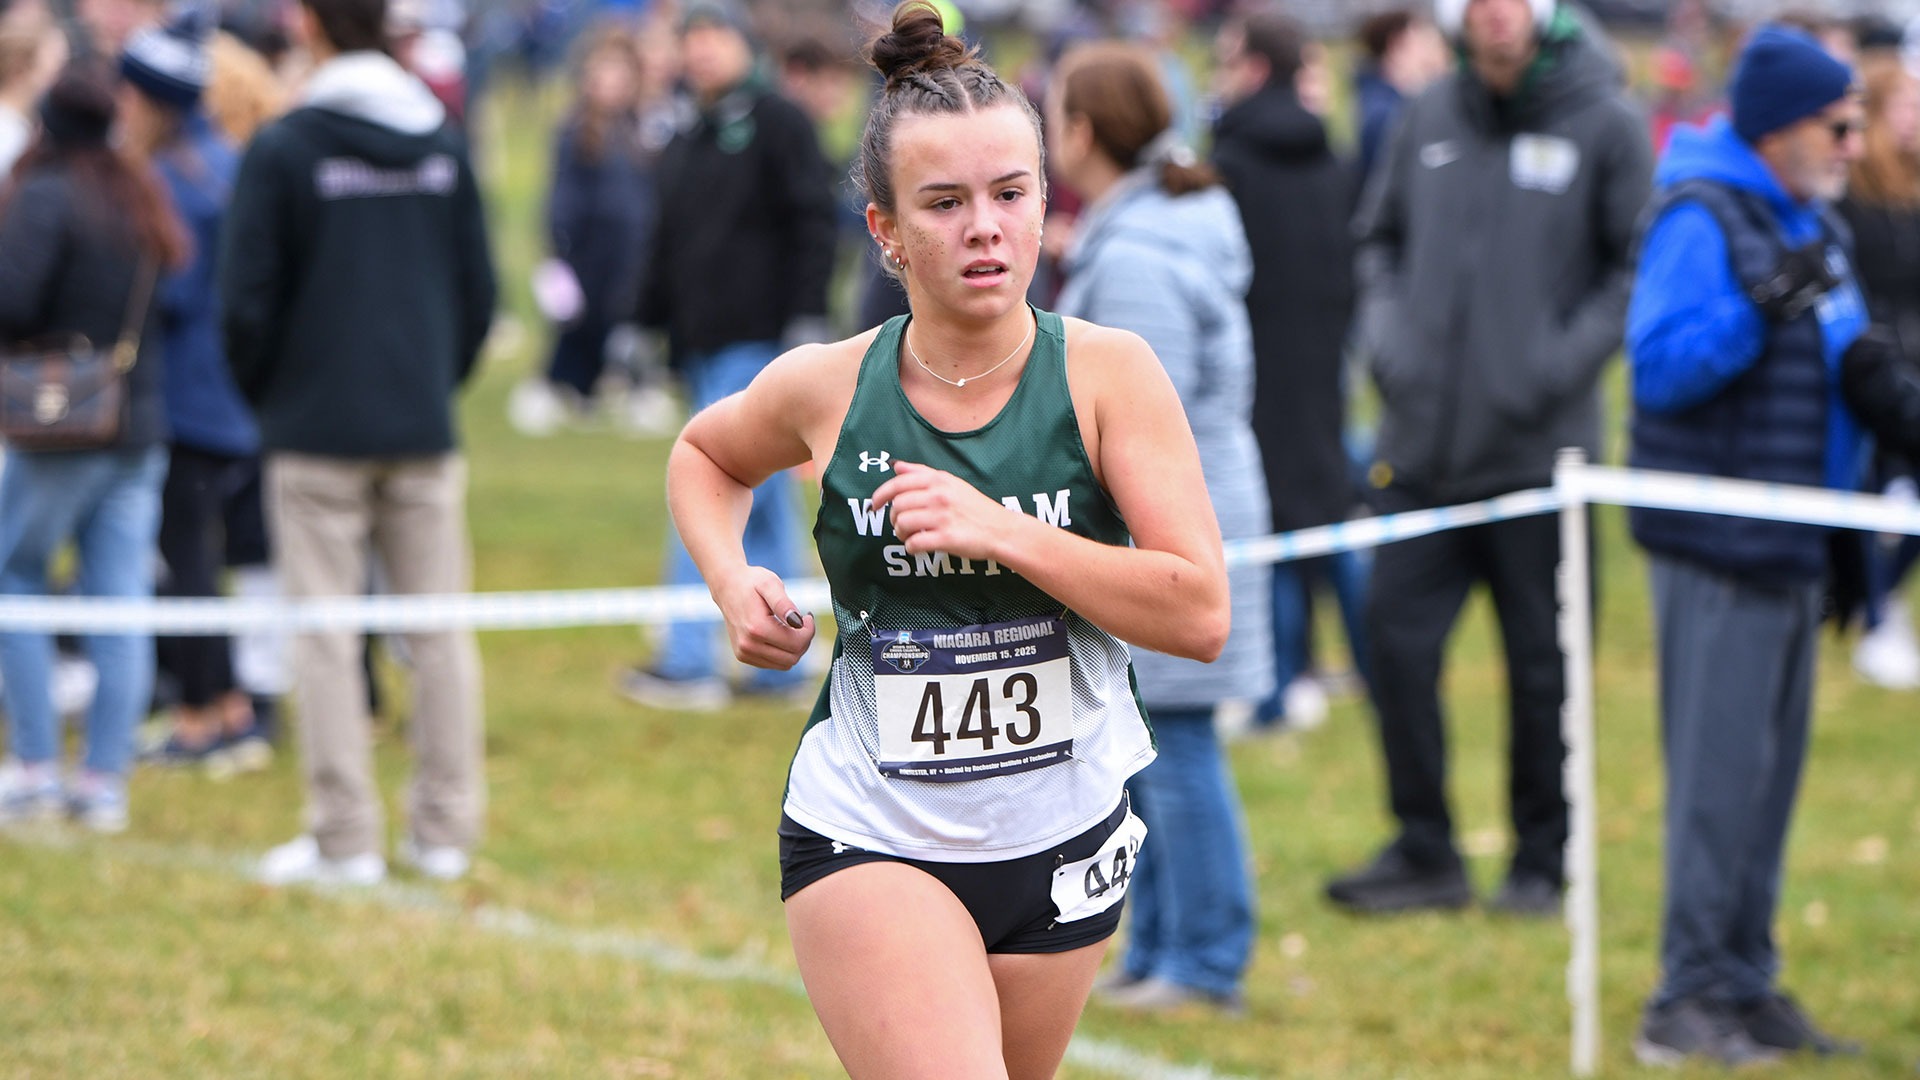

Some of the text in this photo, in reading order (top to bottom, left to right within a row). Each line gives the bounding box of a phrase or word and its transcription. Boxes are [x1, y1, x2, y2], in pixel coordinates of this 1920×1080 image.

[883, 544, 1017, 577] SMI
[933, 621, 1055, 649] NIAGARA REGIONAL
[955, 652, 998, 665] NOVEMBER
[1014, 645, 1037, 657] 2025
[911, 672, 1042, 755] 443
[964, 765, 972, 773] by
[1022, 756, 1029, 764] of
